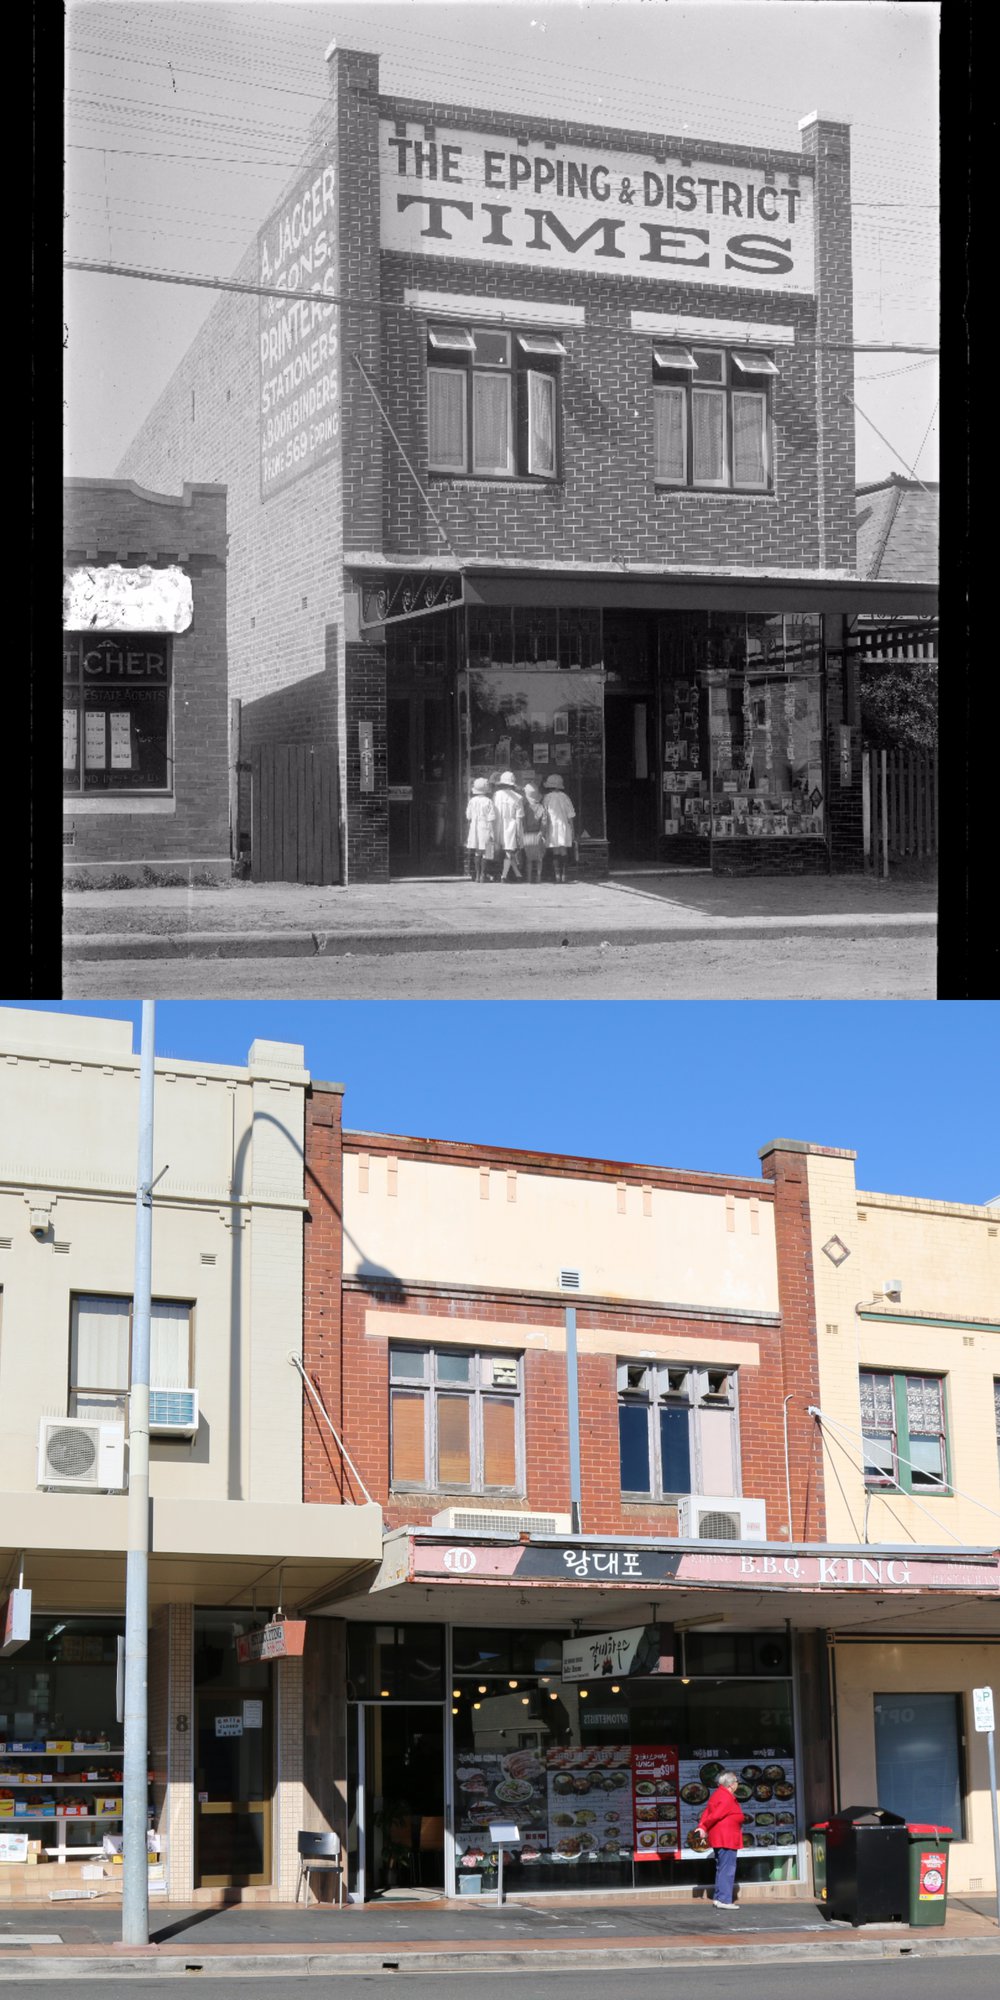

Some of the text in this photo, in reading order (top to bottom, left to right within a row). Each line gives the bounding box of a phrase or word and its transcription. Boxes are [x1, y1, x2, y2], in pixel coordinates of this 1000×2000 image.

[274, 164, 335, 271] JAGGER
[388, 138, 801, 223] THE EPPING & DISTRICT
[396, 193, 794, 275] TIMES
[261, 323, 338, 414] STATIONERS
[267, 369, 338, 449] BOOKBINDERS
[285, 431, 308, 468] 569
[446, 1550, 643, 1577] 10 왕대포
[739, 1556, 806, 1579] B.B.Q.
[817, 1557, 912, 1585] KING
[176, 1714, 189, 1733] 8
